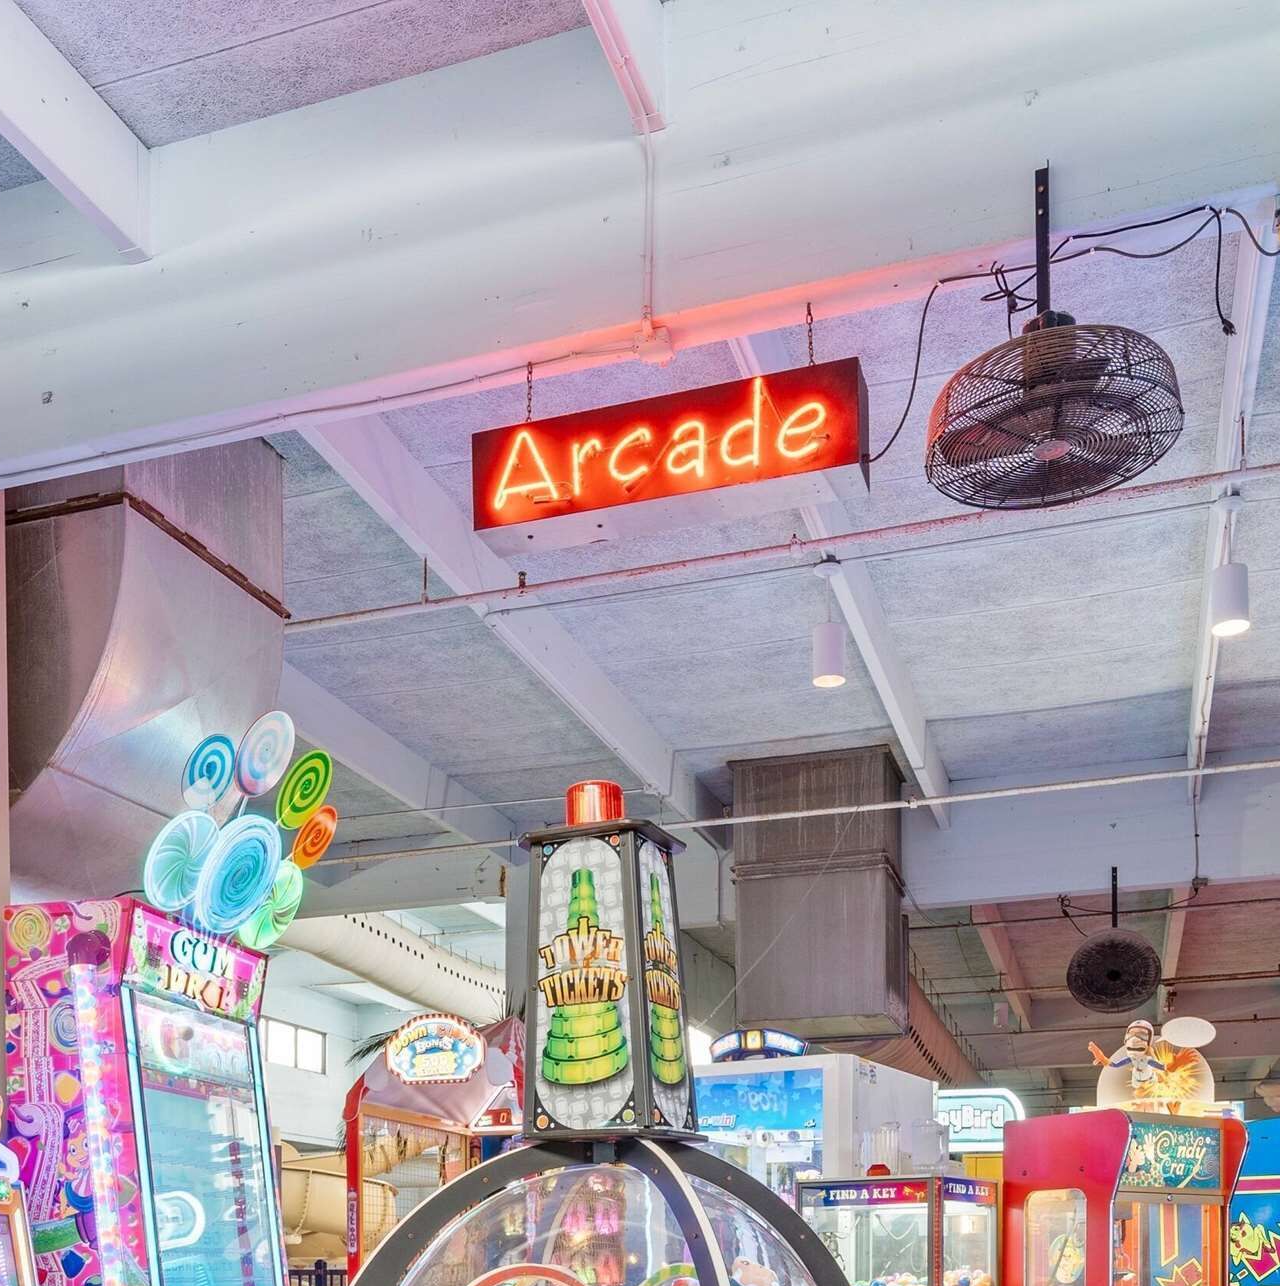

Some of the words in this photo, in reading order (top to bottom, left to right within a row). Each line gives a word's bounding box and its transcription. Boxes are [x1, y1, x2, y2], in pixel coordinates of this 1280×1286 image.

[493, 376, 827, 511] Arcade
[538, 916, 624, 970] TOWER
[538, 967, 626, 1008] TICKETS
[500, 1112, 508, 1123] 0
[829, 1188, 857, 1201] FIND
[860, 1189, 869, 1199] A
[873, 1187, 897, 1199] KEY
[948, 1183, 965, 1195] FIND
[966, 1185, 973, 1195] A
[974, 1184, 990, 1197] KEY
